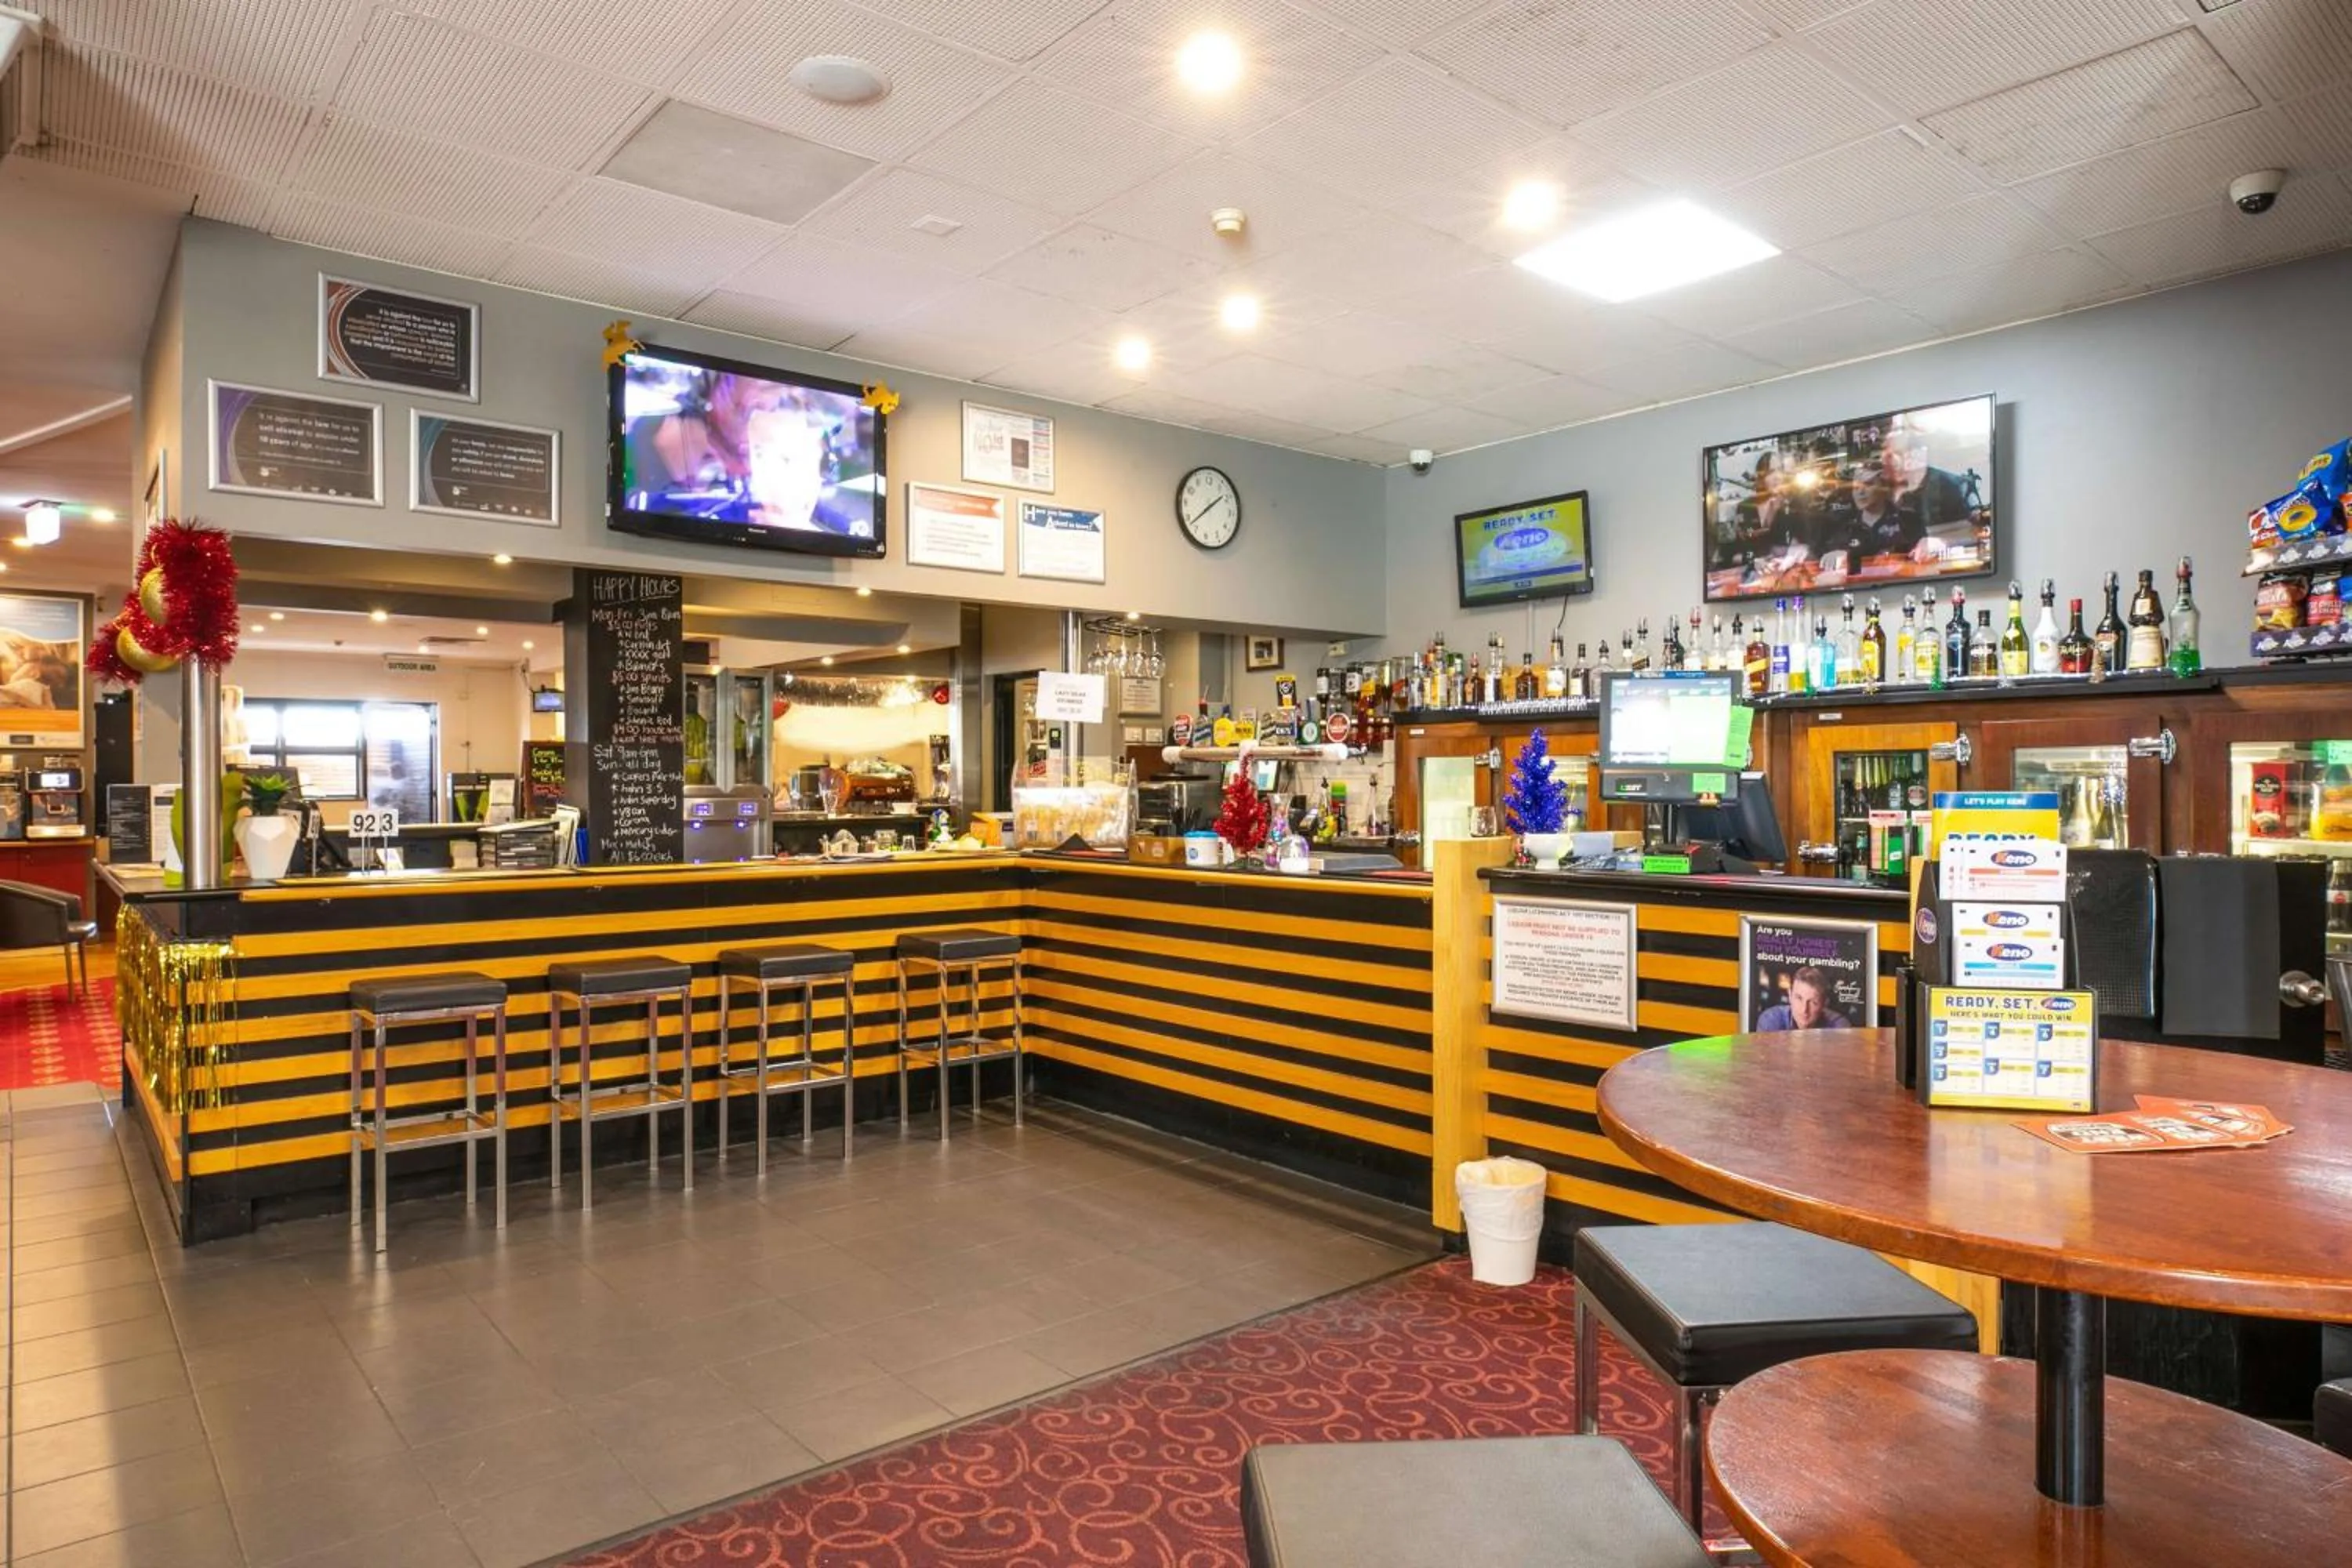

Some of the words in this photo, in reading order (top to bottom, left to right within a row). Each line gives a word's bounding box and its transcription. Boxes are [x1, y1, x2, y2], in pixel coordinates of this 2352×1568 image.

[593, 576, 635, 601] HAPPY
[354, 815, 375, 832] 92
[1995, 851, 2035, 865] Keno
[1987, 912, 2027, 925] Keno
[1756, 925, 1772, 934] Are
[1991, 944, 2030, 959] Keno
[1757, 952, 1784, 962] about
[1786, 956, 1806, 964] your
[1809, 957, 1860, 970] gambling?
